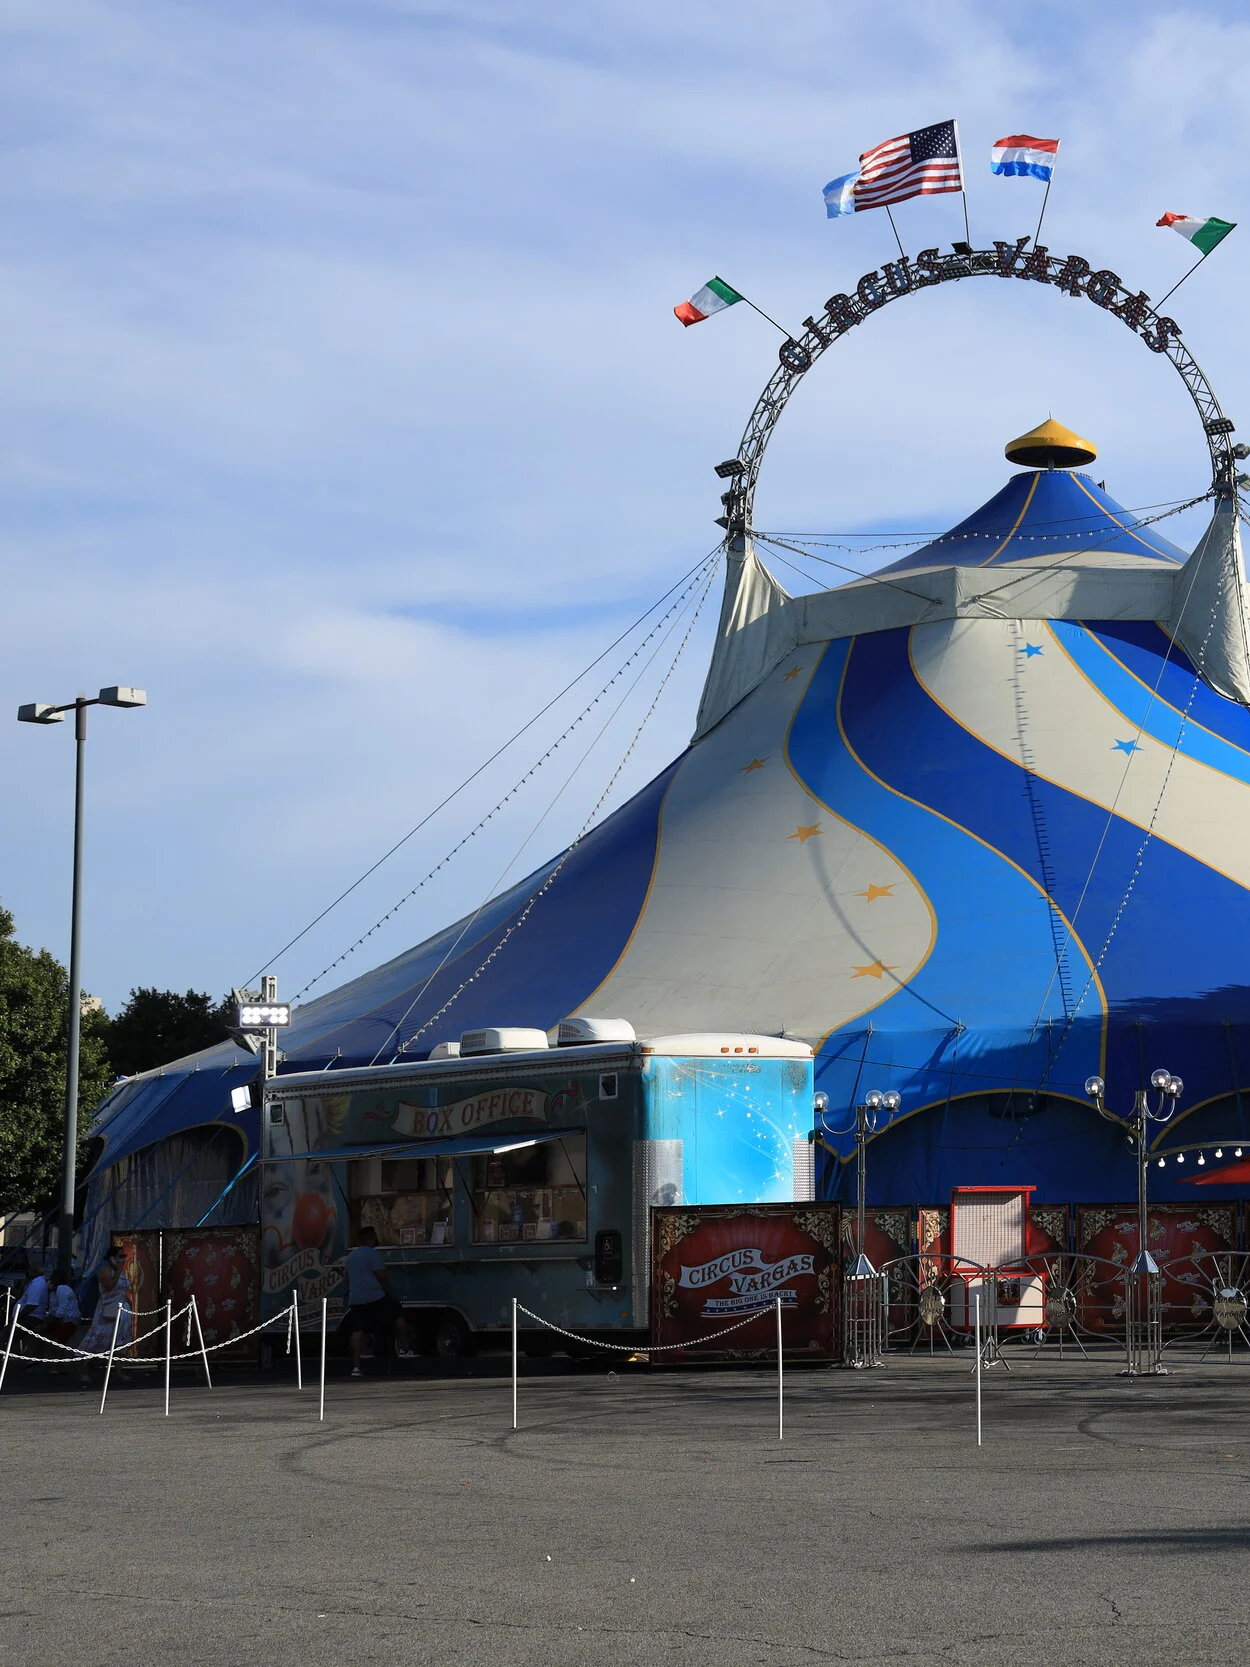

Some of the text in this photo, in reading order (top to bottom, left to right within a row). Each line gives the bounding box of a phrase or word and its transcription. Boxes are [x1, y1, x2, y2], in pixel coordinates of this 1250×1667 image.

[779, 236, 1182, 374] CIRCUS VARGAS
[413, 1091, 535, 1133] BOX OFFICE
[269, 1250, 314, 1290] CIRCUS
[689, 1250, 753, 1285] CIRCUS
[734, 1256, 812, 1292] VARGAS
